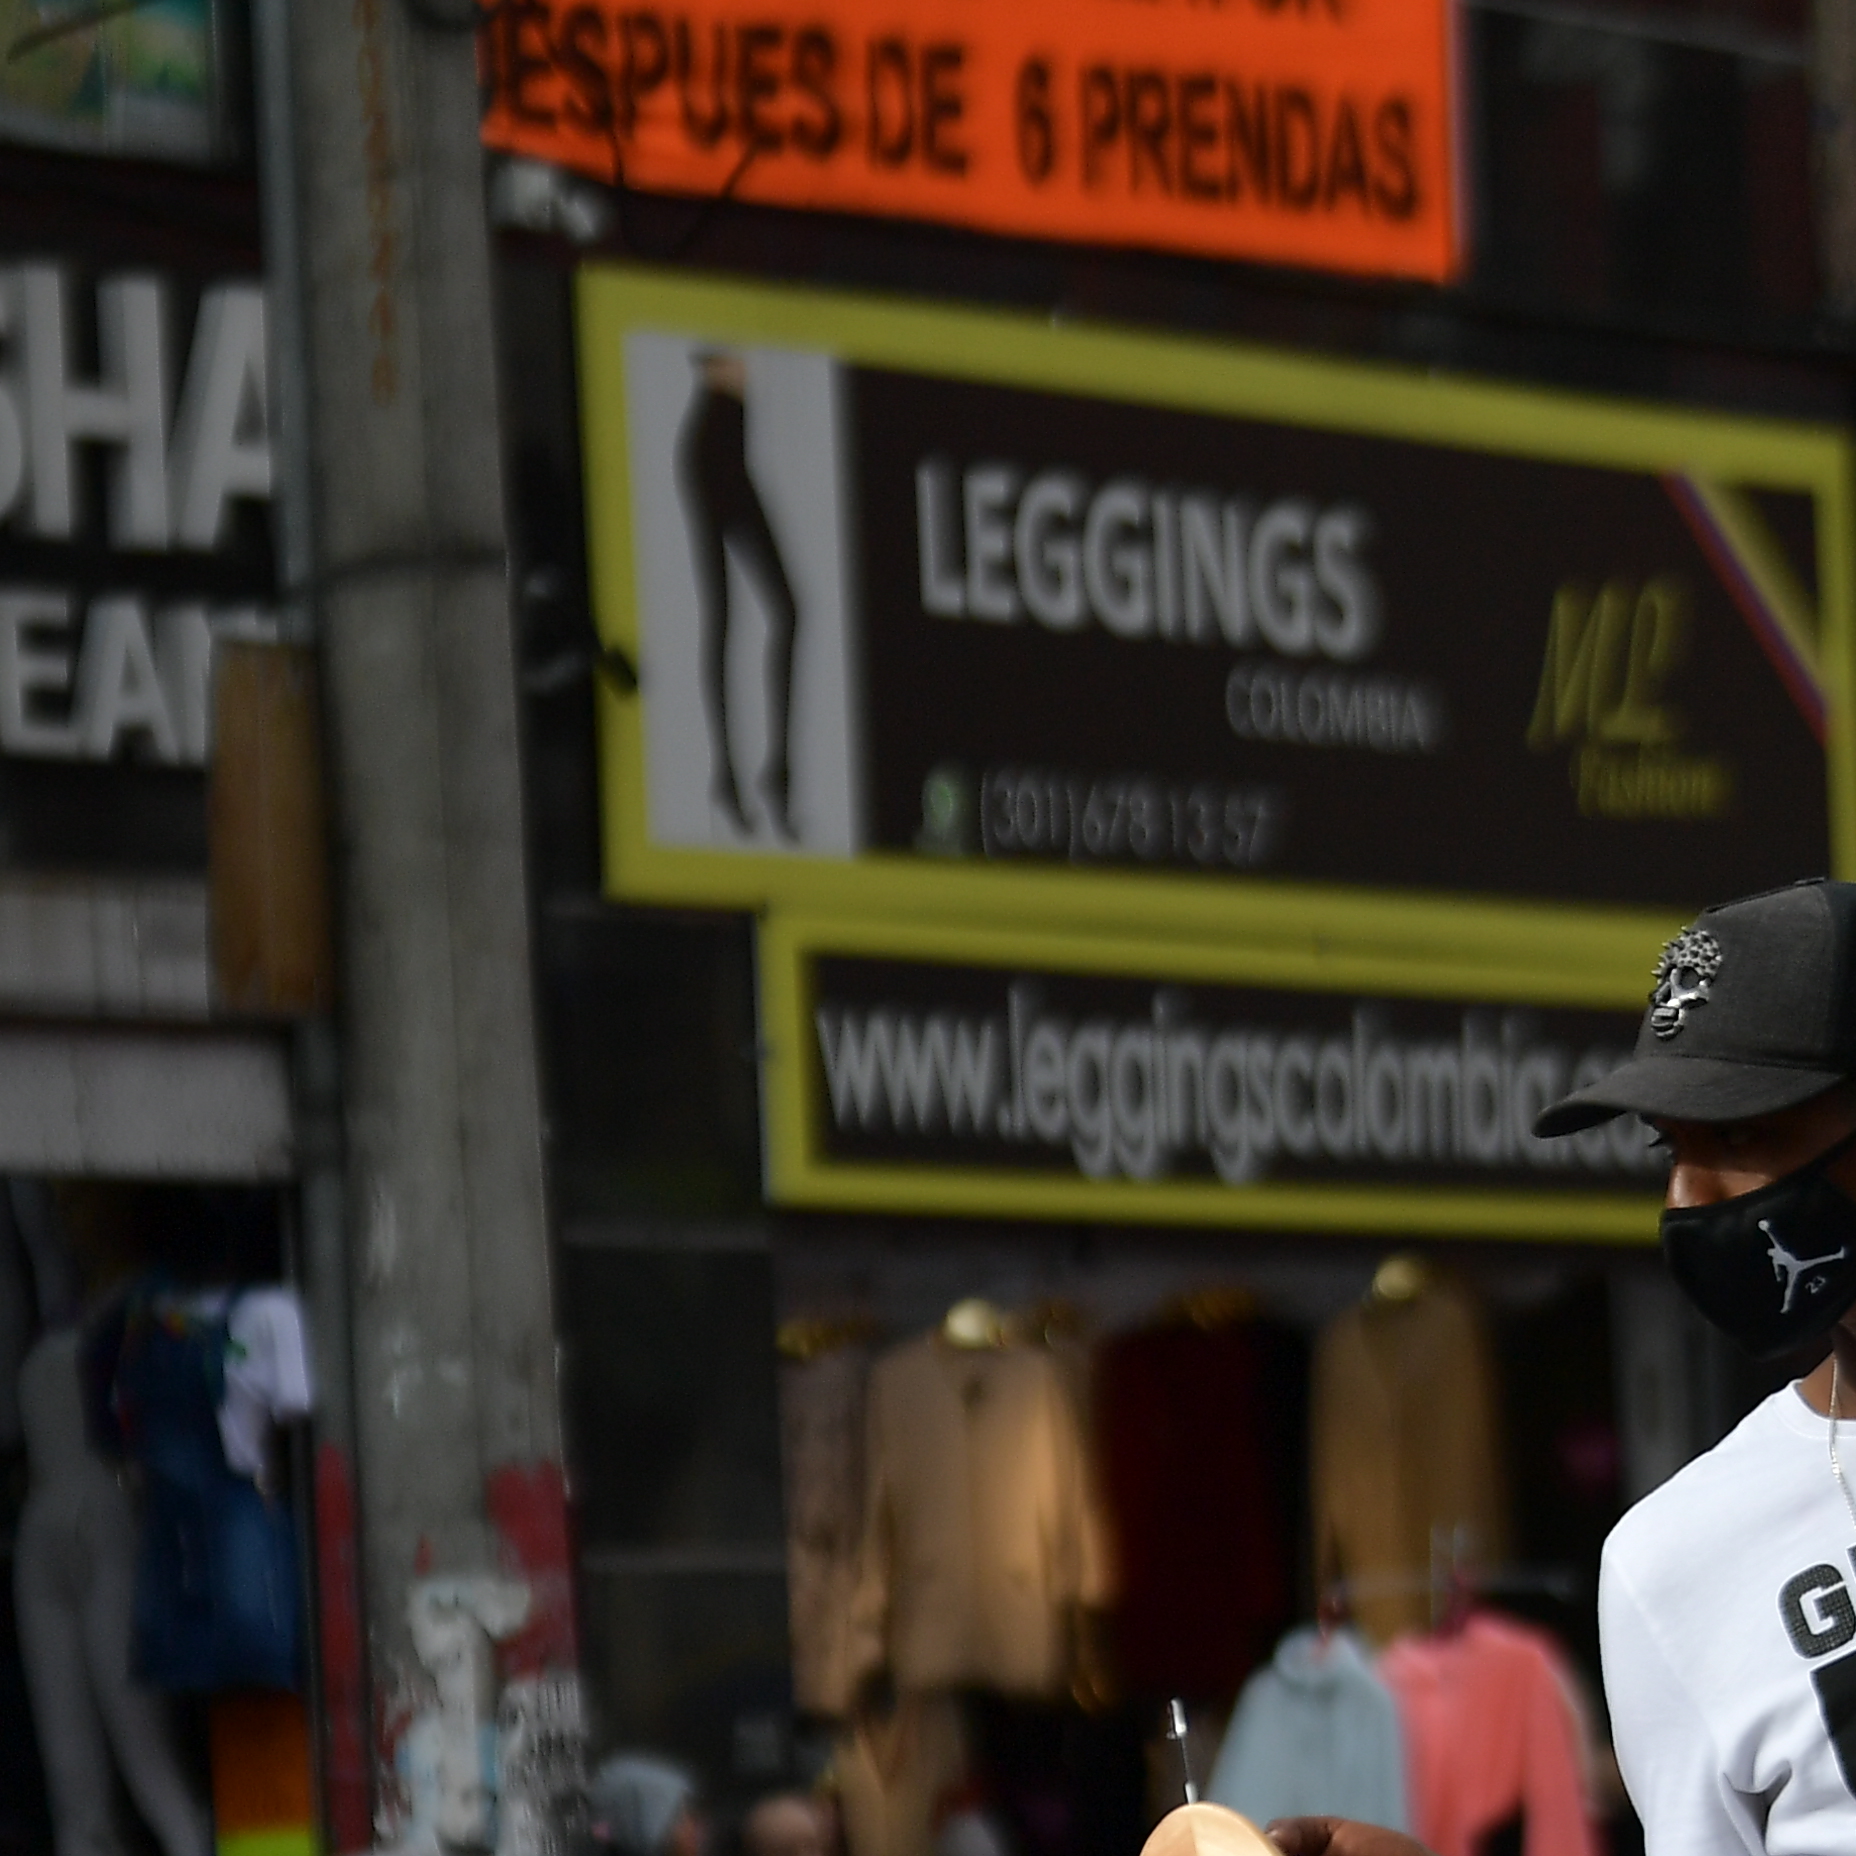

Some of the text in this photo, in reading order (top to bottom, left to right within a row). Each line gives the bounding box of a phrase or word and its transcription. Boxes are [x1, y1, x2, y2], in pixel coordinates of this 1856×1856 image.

[865, 40, 966, 172] DE
[1015, 58, 1056, 184] 6
[1080, 64, 1418, 218] PRENDAS
[914, 458, 1380, 666] LEGGINGS
[1224, 662, 1446, 756] COLOMBIA
